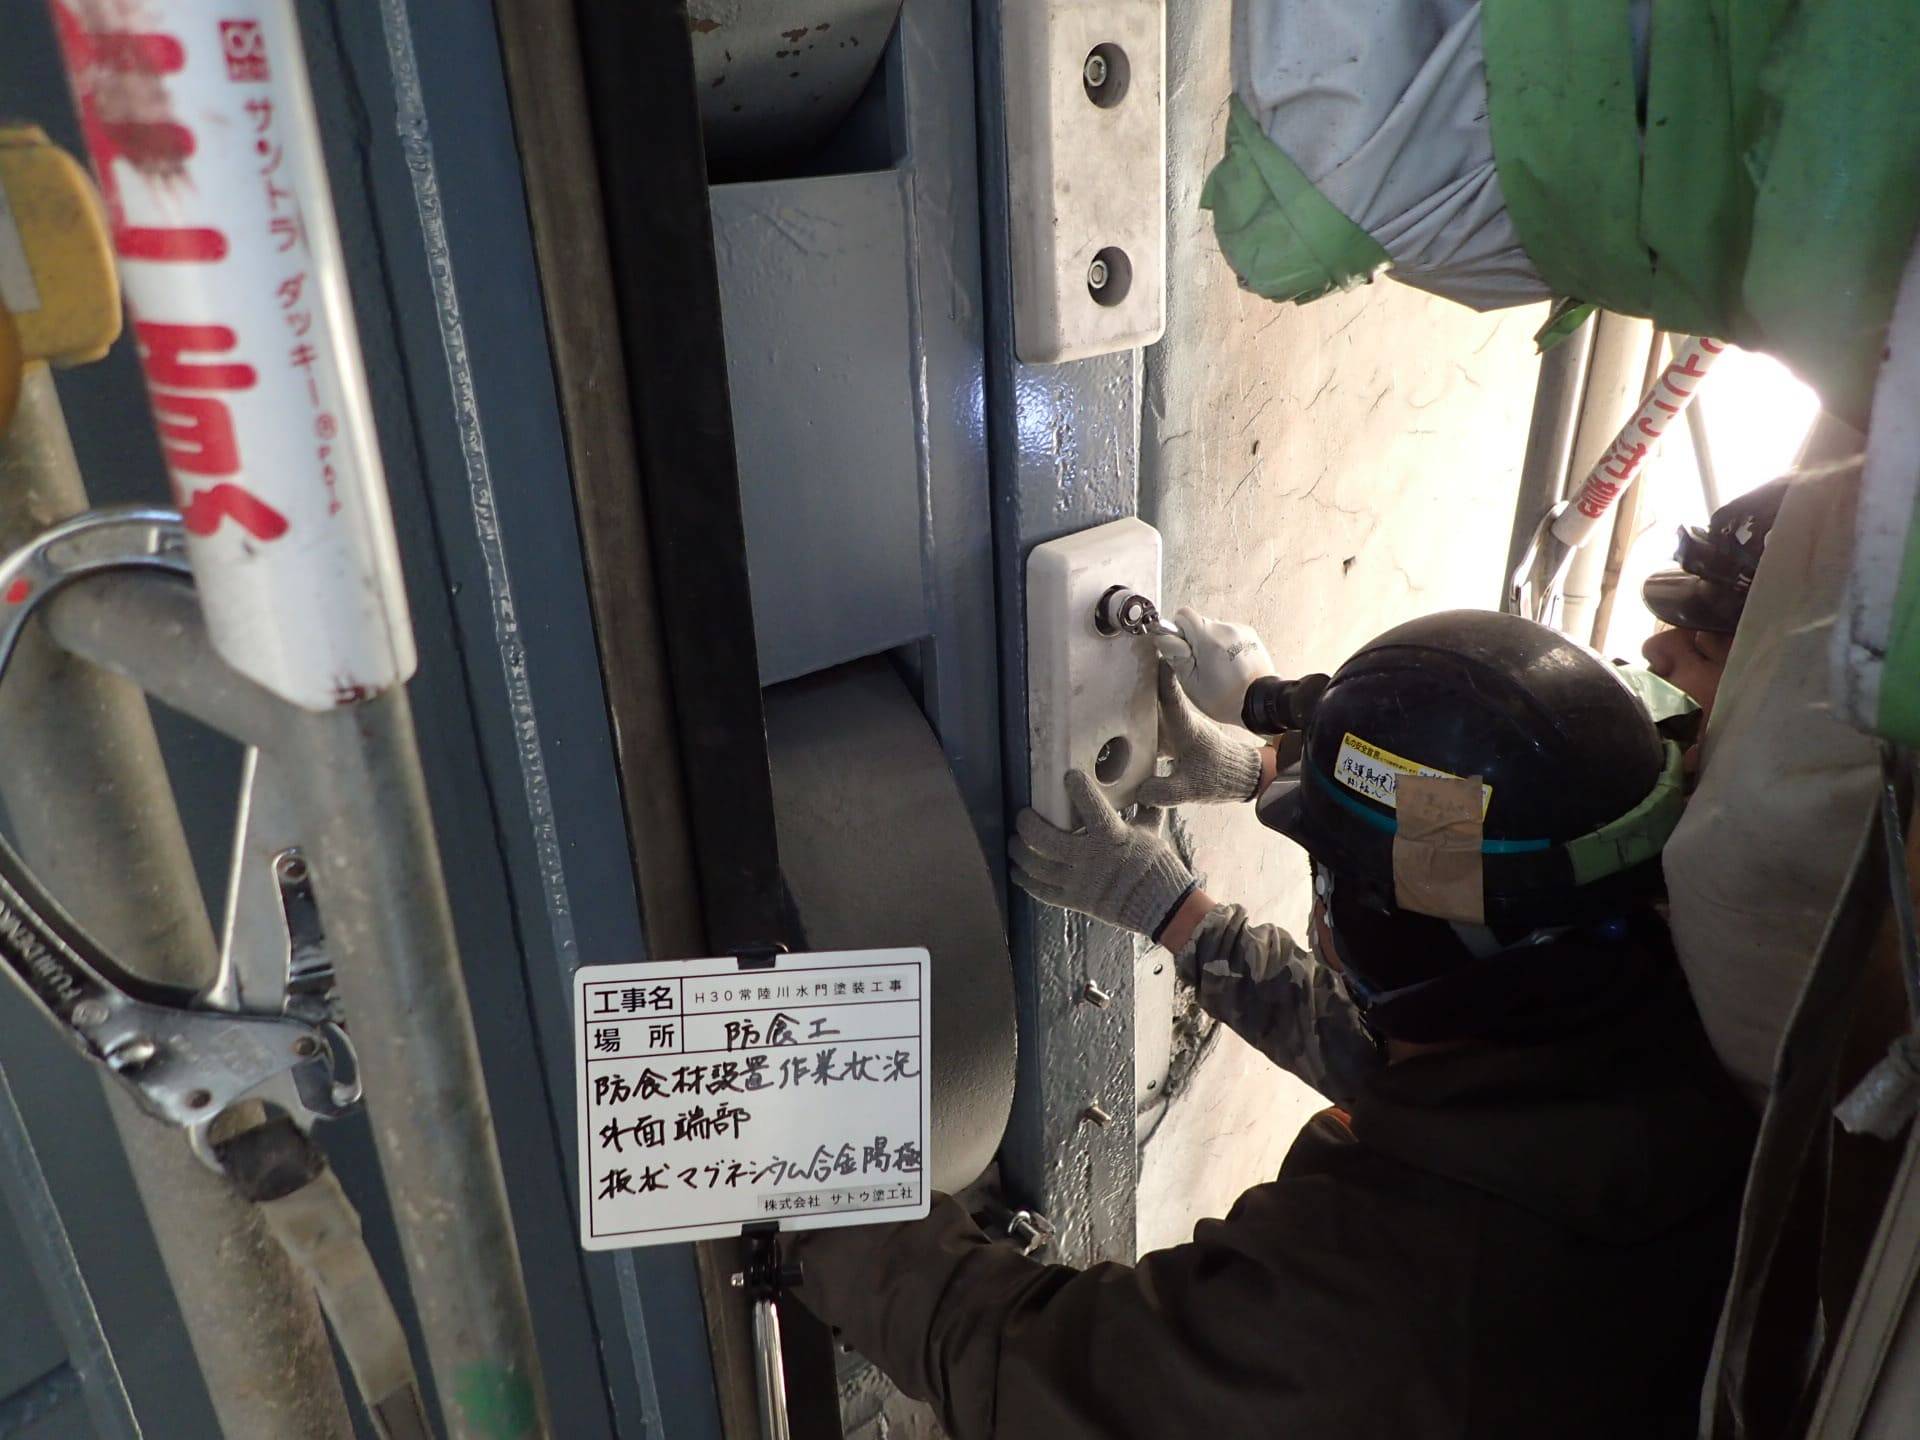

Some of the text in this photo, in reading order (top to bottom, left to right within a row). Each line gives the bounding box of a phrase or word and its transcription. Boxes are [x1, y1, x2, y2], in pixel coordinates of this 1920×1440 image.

[593, 985, 673, 1014] 工事名
[695, 979, 902, 1004] H30常陸川水門塗装工事
[724, 1013, 840, 1052] 防食工
[594, 1048, 920, 1105] 防食材設置作業状況
[599, 1102, 751, 1152] 外面端部
[764, 1186, 912, 1212] 株式会社 サトウ塗工社
